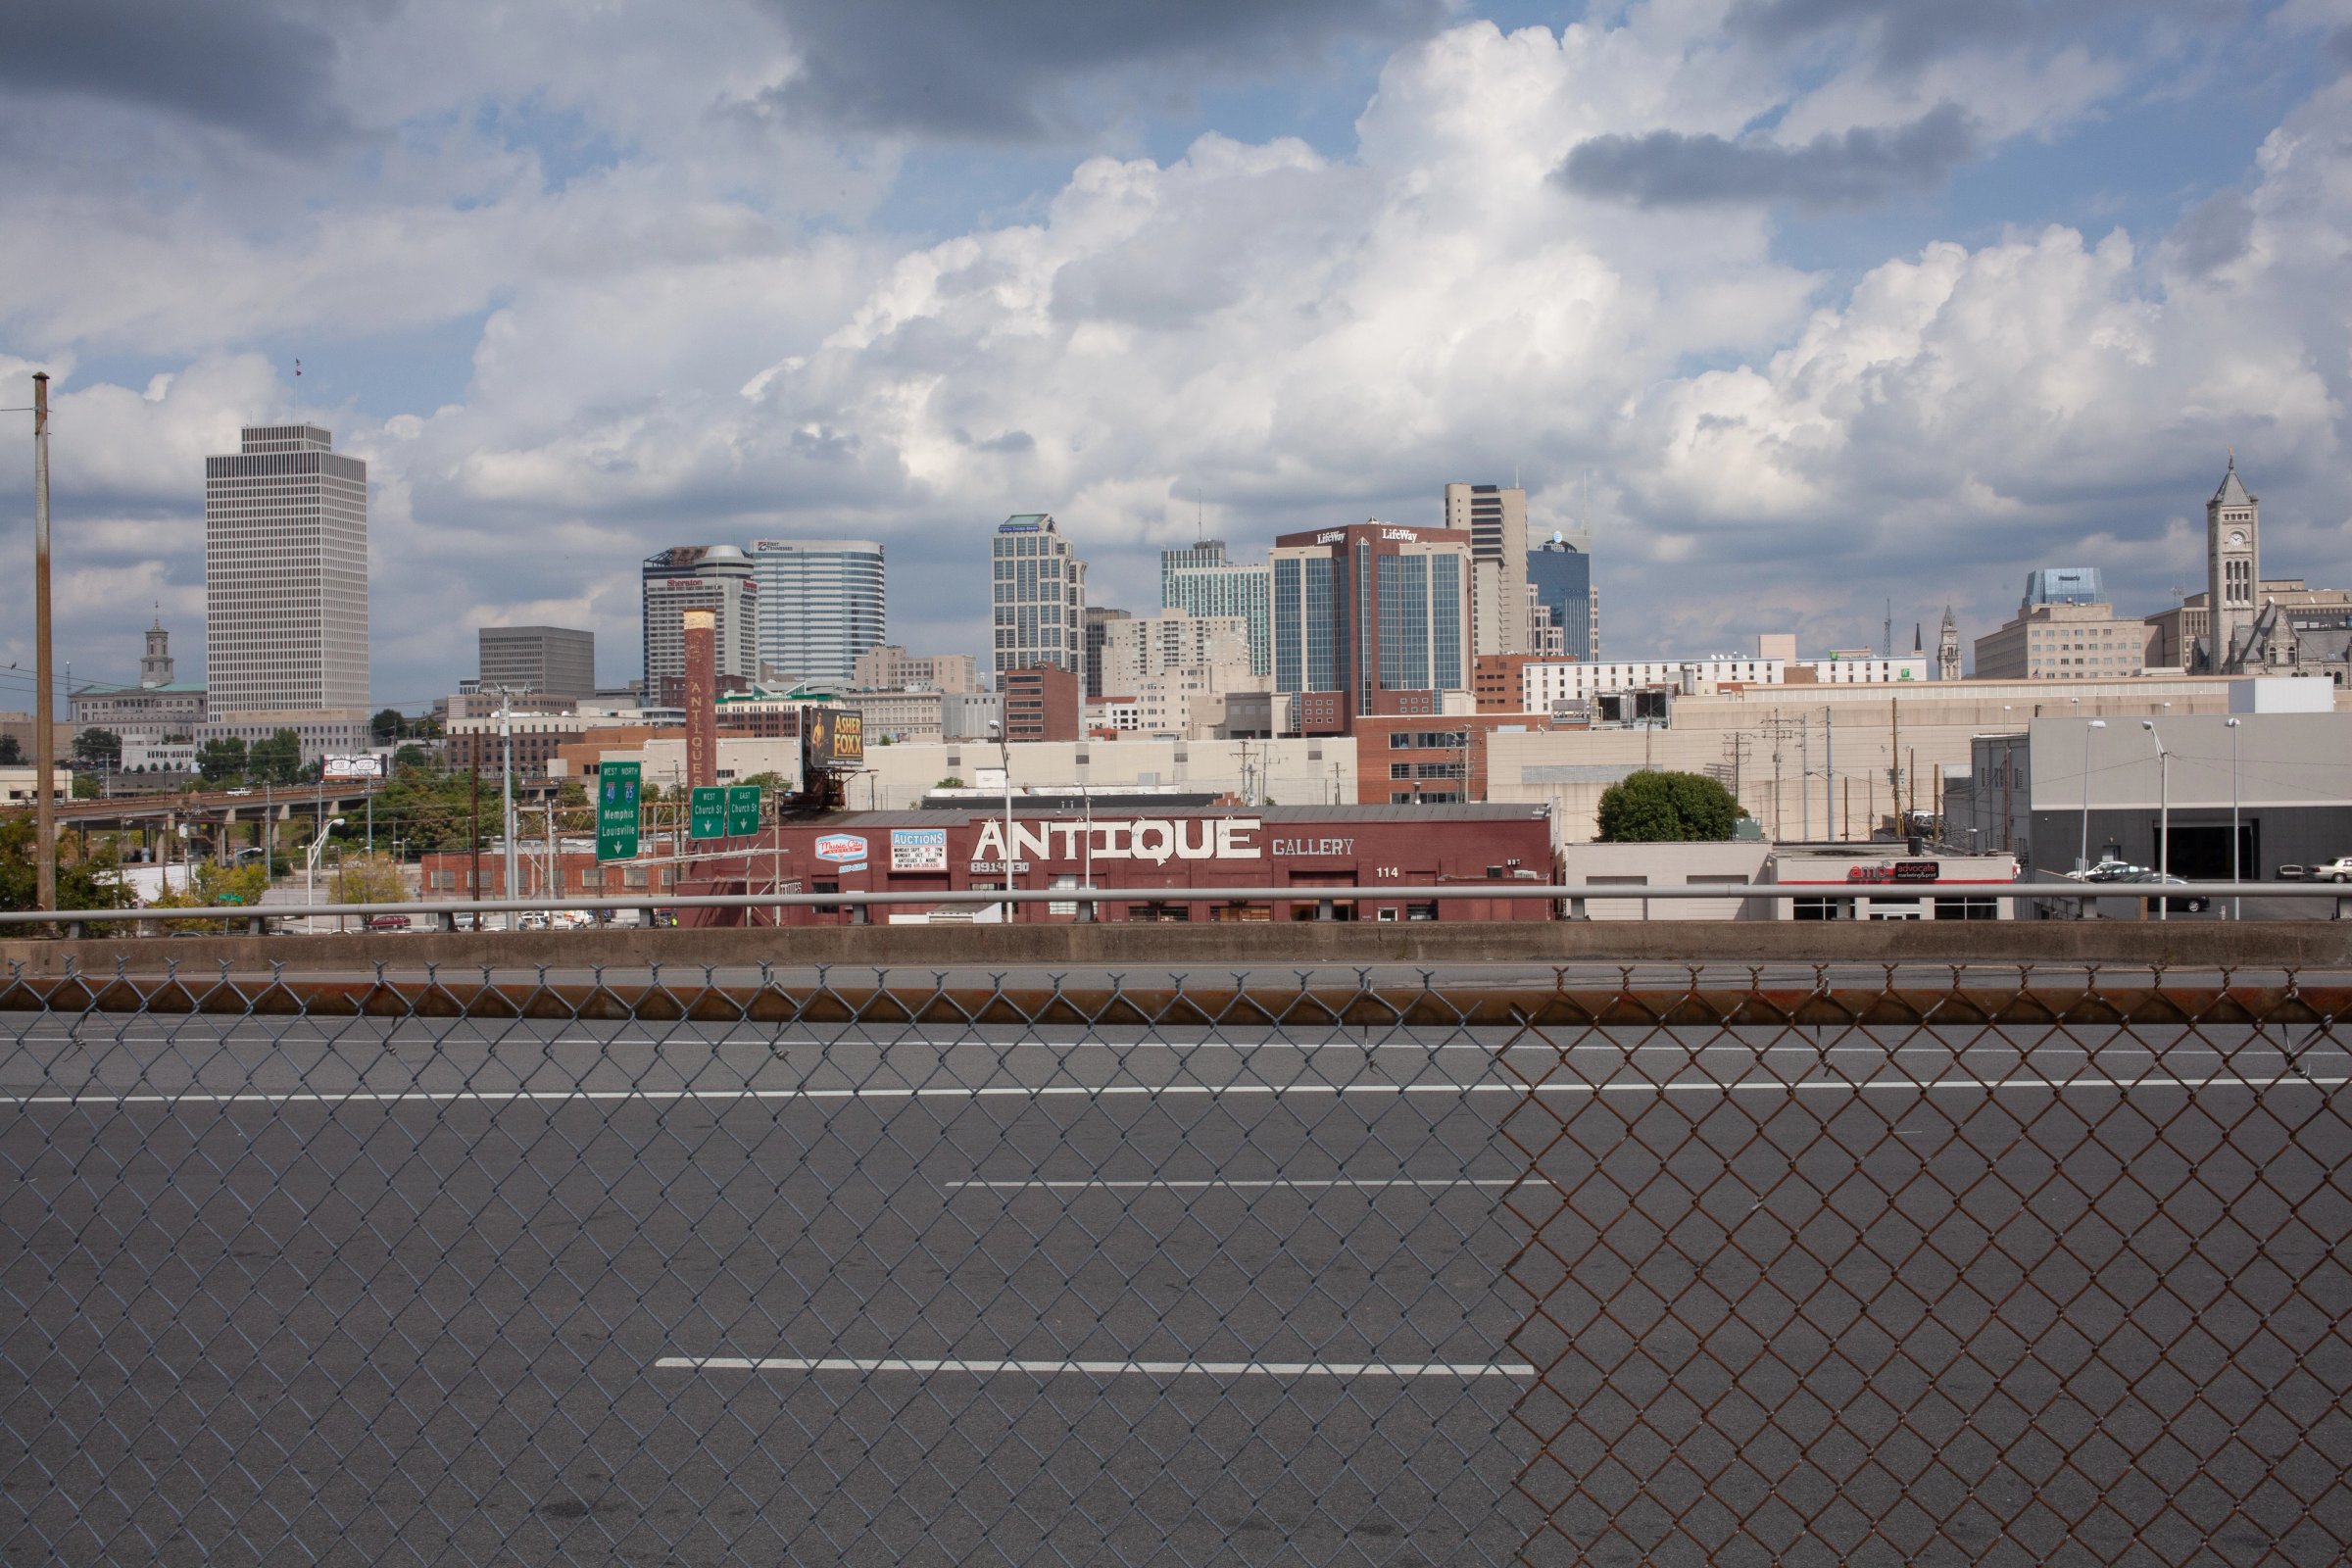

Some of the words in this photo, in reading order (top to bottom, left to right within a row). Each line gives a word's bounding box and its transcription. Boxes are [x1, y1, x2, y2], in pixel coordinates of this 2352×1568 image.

[1316, 530, 1347, 545] LifeWay
[1382, 528, 1418, 543] LifeWay
[834, 715, 861, 734] ASHER
[690, 682, 703, 787] ANTIQUES
[833, 734, 861, 757] FOXX
[604, 767, 617, 776] WEST
[621, 767, 639, 776] NORTH
[607, 788, 615, 799] 40
[625, 787, 634, 799] 65
[695, 805, 715, 815] Church
[715, 805, 722, 814] St
[731, 804, 751, 813] Church
[751, 803, 758, 812] St
[604, 809, 634, 820] Memphis
[602, 826, 635, 837] Louisville
[894, 833, 943, 845] AUCTIONS
[970, 818, 1262, 867] ANTIQUE
[1272, 838, 1354, 856] GALLERY
[970, 861, 1030, 872] 891-430
[1376, 866, 1398, 878] 114
[1898, 863, 1936, 872] advocate
